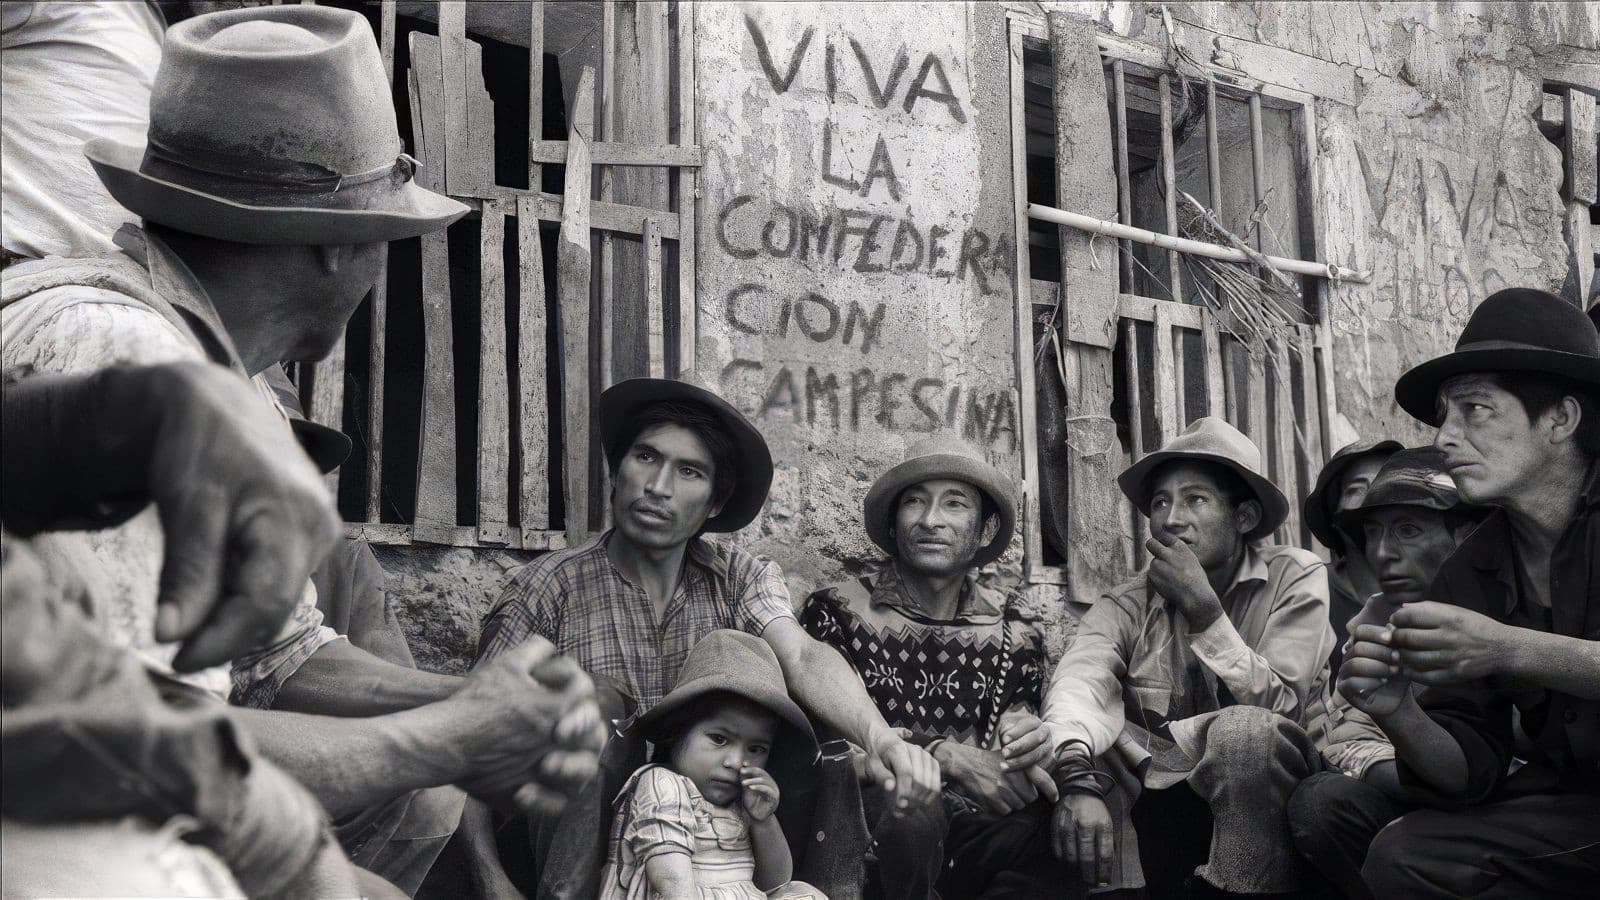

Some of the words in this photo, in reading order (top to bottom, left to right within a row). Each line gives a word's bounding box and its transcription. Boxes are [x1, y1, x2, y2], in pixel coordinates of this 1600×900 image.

[745, 15, 967, 124] VIVA
[822, 118, 902, 202] LA
[725, 283, 886, 353] CION
